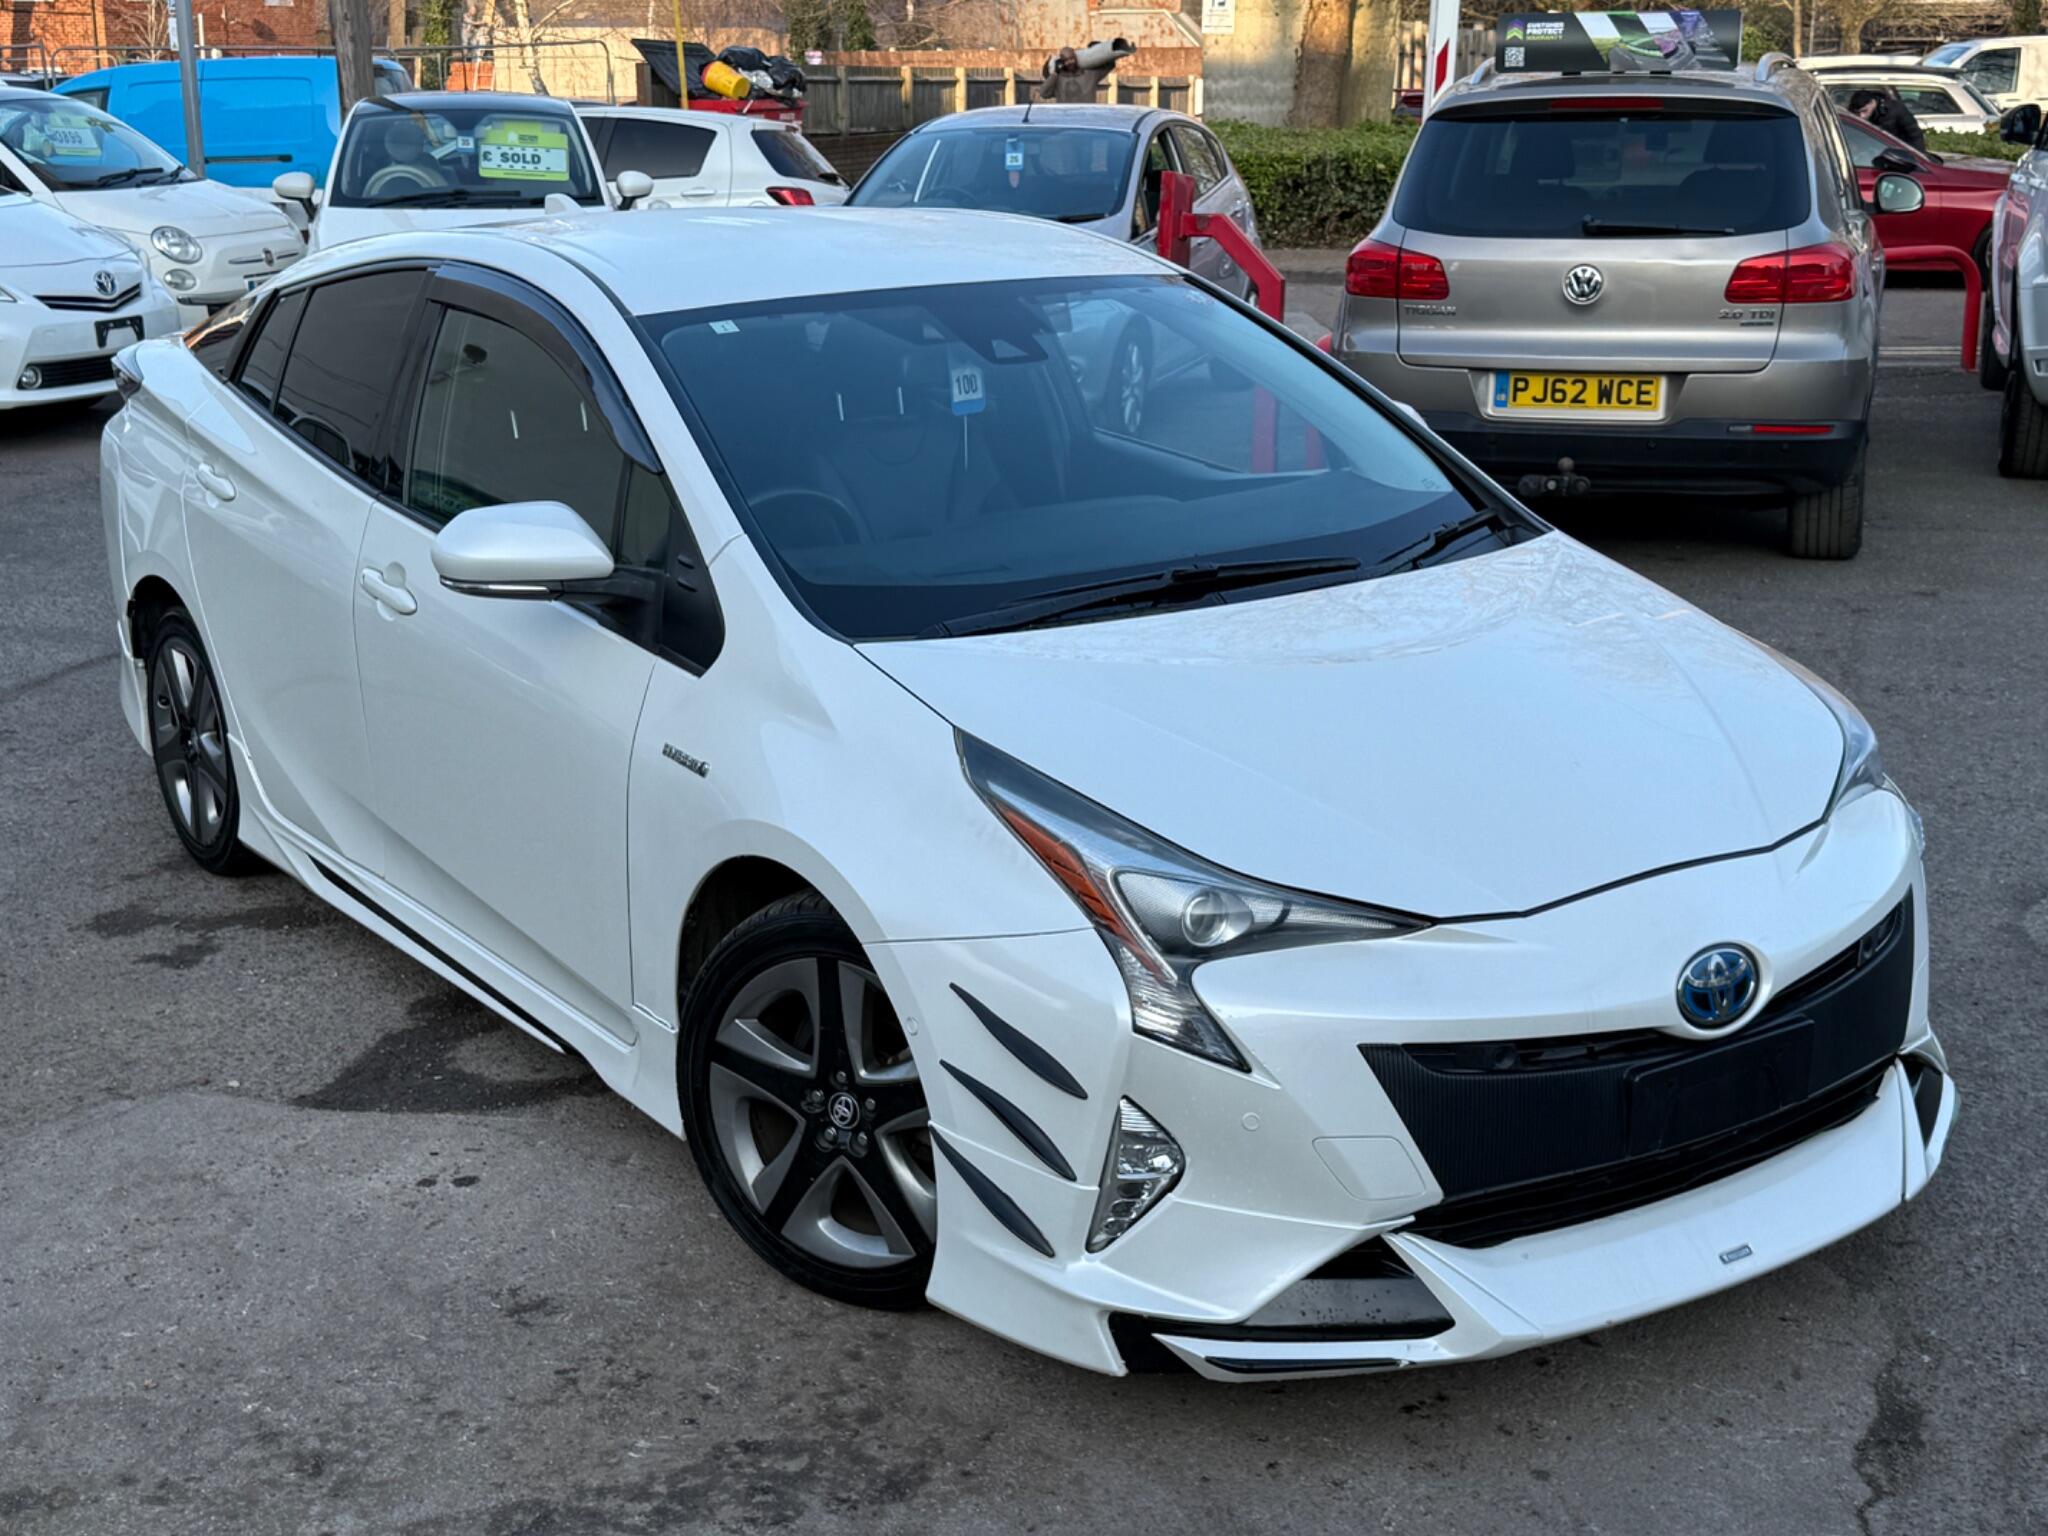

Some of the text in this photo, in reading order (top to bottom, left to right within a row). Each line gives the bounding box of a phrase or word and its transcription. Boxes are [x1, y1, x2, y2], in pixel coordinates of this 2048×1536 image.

[500, 152, 542, 165] SOLD
[1718, 308, 1776, 320] 2.0 TDI
[955, 374, 978, 396] 100
[1511, 377, 1654, 405] PJ62 WCE
